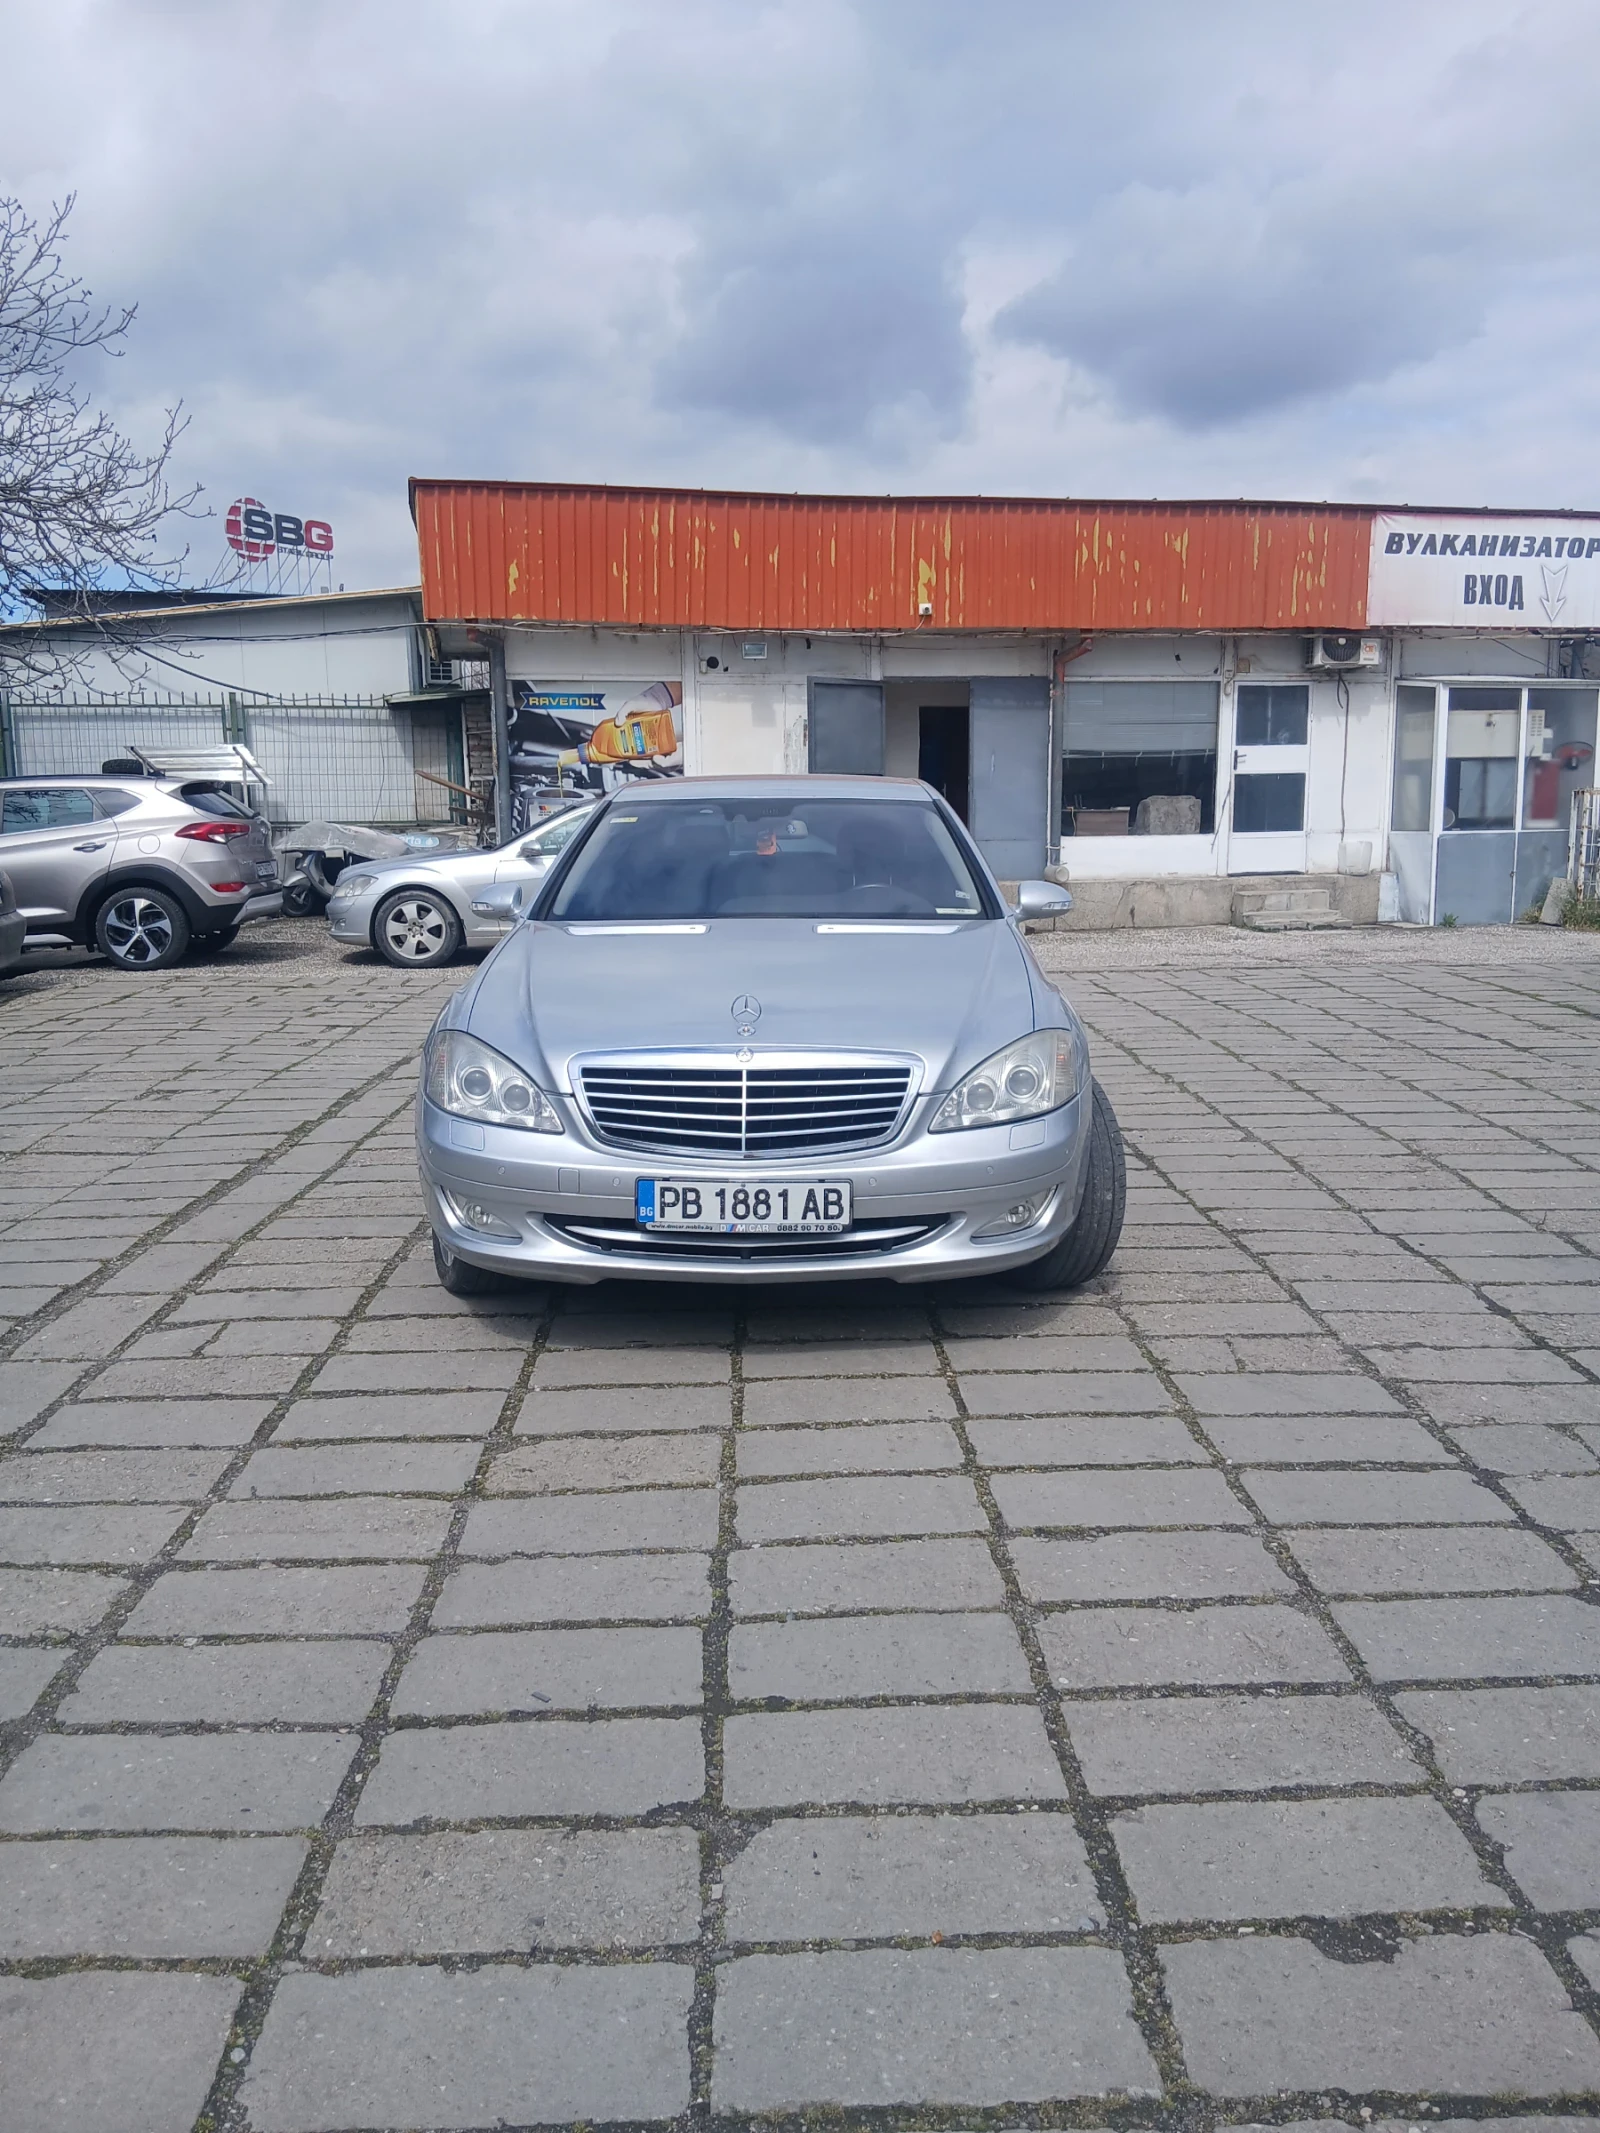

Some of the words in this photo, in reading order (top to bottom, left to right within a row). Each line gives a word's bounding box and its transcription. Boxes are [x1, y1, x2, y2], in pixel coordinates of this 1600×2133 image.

[243, 508, 334, 552] SBG
[1384, 532, 1600, 559] ВУЛКАНИЗАТОР
[1463, 574, 1525, 611] ВХОД
[529, 697, 599, 707] RAVENOL
[640, 1207, 653, 1217] BG
[660, 1186, 702, 1219] PB
[715, 1188, 789, 1220] 1881
[801, 1188, 844, 1220] AB
[749, 1224, 769, 1232] CAR
